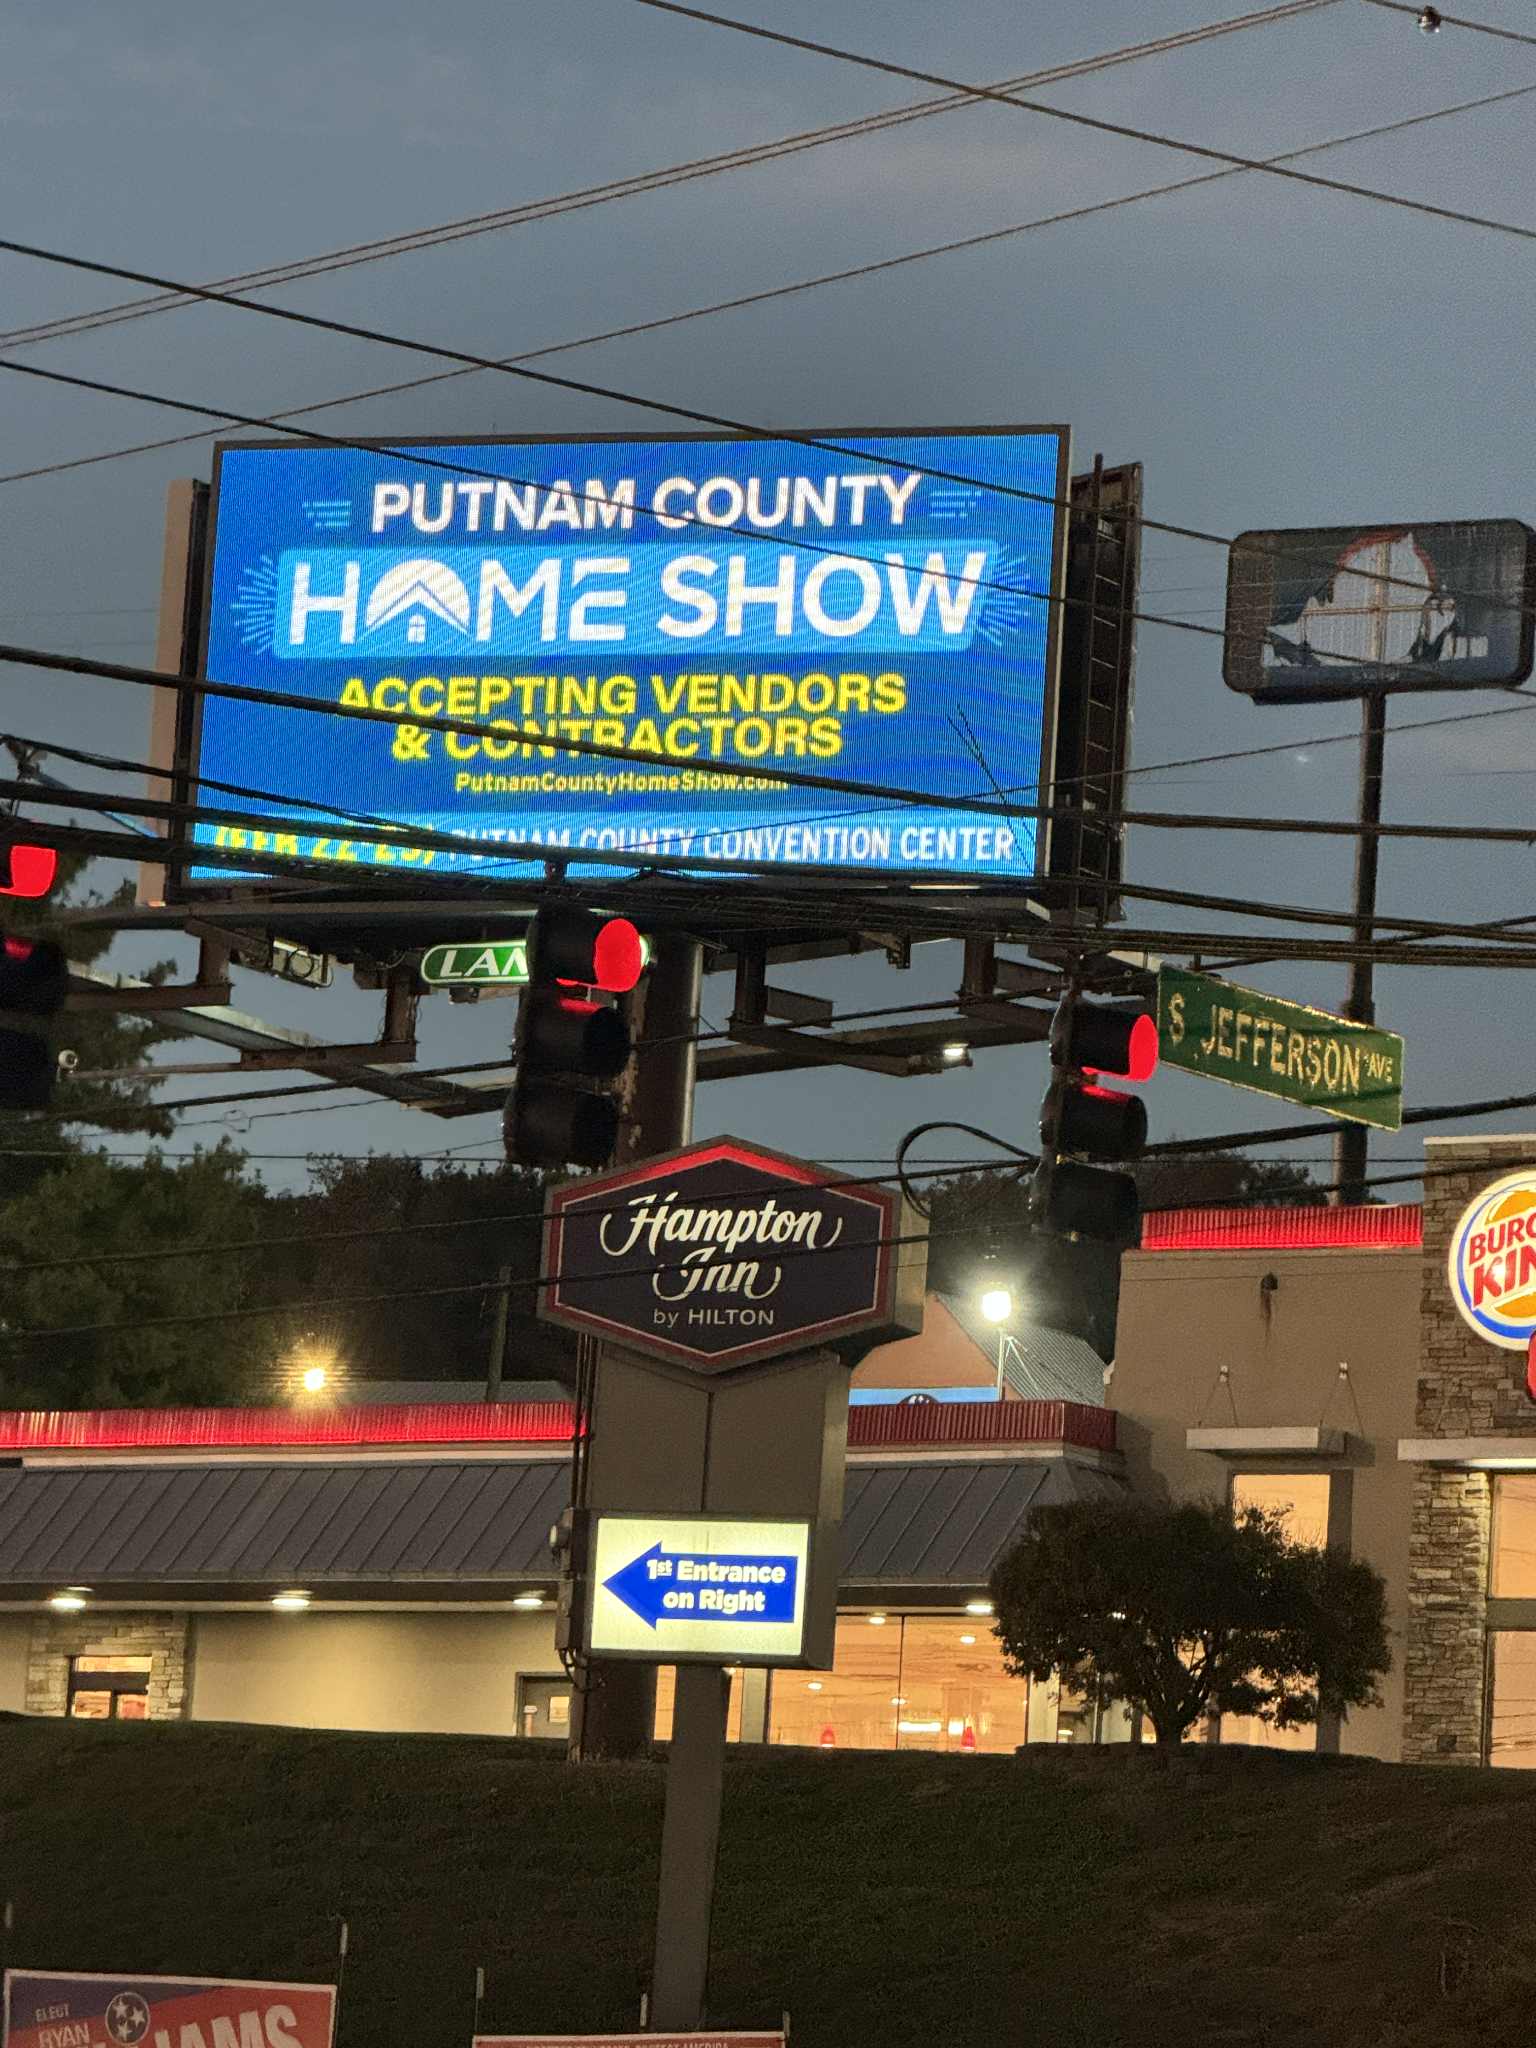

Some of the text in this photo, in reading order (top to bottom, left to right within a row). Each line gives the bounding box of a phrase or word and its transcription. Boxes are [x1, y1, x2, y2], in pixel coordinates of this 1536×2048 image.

[372, 475, 922, 533] PUTNAM COUNTY
[289, 552, 987, 645] HOME SHOW
[339, 673, 907, 716] ACCEPTING VENDORS
[392, 718, 843, 760] & CONTRACTORS
[580, 828, 696, 858] COUNTY
[703, 827, 889, 860] CONVENTION
[900, 825, 1015, 860] CENTER
[1168, 992, 1393, 1096] S JEFFERSON AVE
[600, 1191, 843, 1256] Hampton
[652, 1246, 782, 1301] Inn
[653, 1308, 775, 1328] by HILTON
[647, 1559, 786, 1584] 1st Entrance
[662, 1589, 766, 1614] on Right
[35, 2003, 70, 2022] ELECT
[39, 2021, 91, 2048] RYAN
